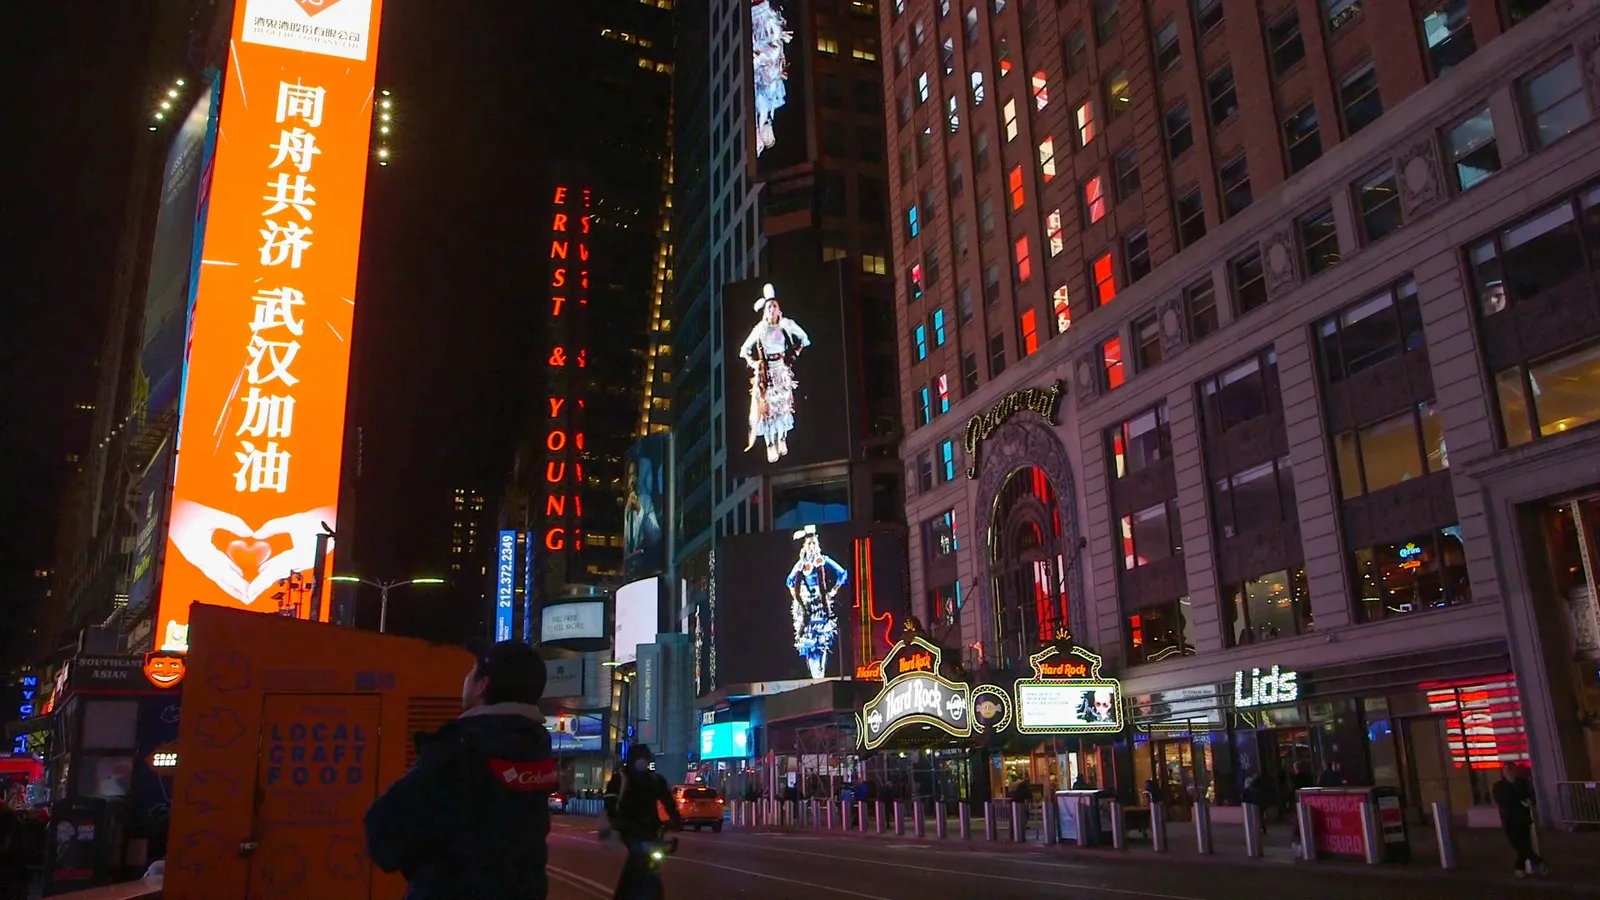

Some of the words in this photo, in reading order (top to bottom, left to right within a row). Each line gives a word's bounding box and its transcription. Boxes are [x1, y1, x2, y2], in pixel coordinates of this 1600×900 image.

[259, 81, 325, 268] 同舟共济
[551, 187, 569, 316] ERNST
[548, 347, 567, 366] &
[234, 287, 306, 493] 武汉加油
[964, 381, 1061, 479] Paramount
[546, 398, 567, 550] YOUNG
[501, 535, 513, 608] 212.372.2349
[78, 657, 144, 667] SOUTHEAST
[856, 666, 880, 678] Hard
[899, 655, 915, 672] Hard
[915, 651, 931, 671] Rock
[1041, 664, 1064, 676] Hard
[1064, 664, 1086, 677] Rock
[92, 670, 127, 679] ASIAN
[1235, 665, 1298, 708] Lids
[886, 682, 913, 722] Hard
[913, 679, 943, 717] Rock
[272, 723, 366, 742] LOCAL
[269, 745, 367, 764] CRAFT
[268, 766, 364, 786] FOOD
